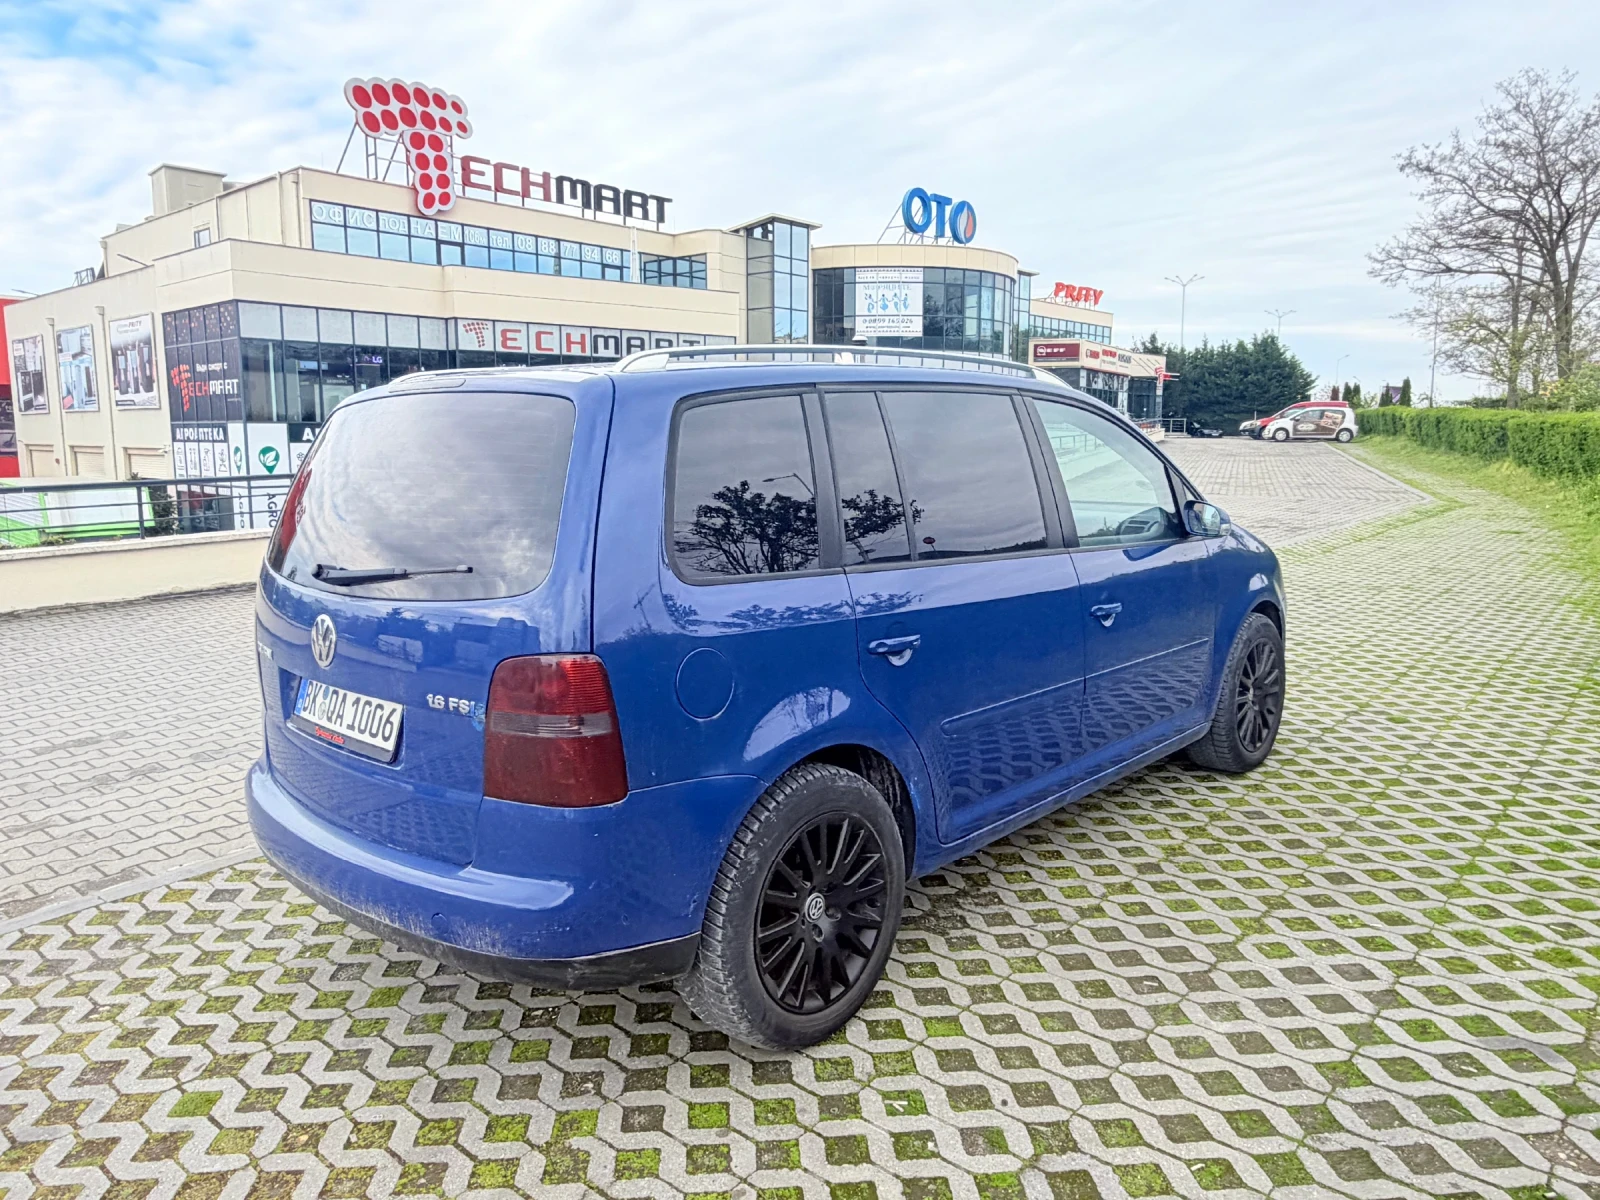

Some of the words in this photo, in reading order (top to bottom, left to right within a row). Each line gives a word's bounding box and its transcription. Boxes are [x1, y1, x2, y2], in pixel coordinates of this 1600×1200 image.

[312, 203, 375, 227] ОФИС
[410, 223, 463, 241] НАЕМ
[517, 237, 533, 250] 08
[540, 240, 556, 255] 88
[563, 243, 577, 257] 77
[583, 247, 598, 261] 94
[605, 250, 620, 263] 66
[303, 681, 323, 717] BK
[346, 697, 397, 743] 1006
[448, 697, 476, 717] FSI
